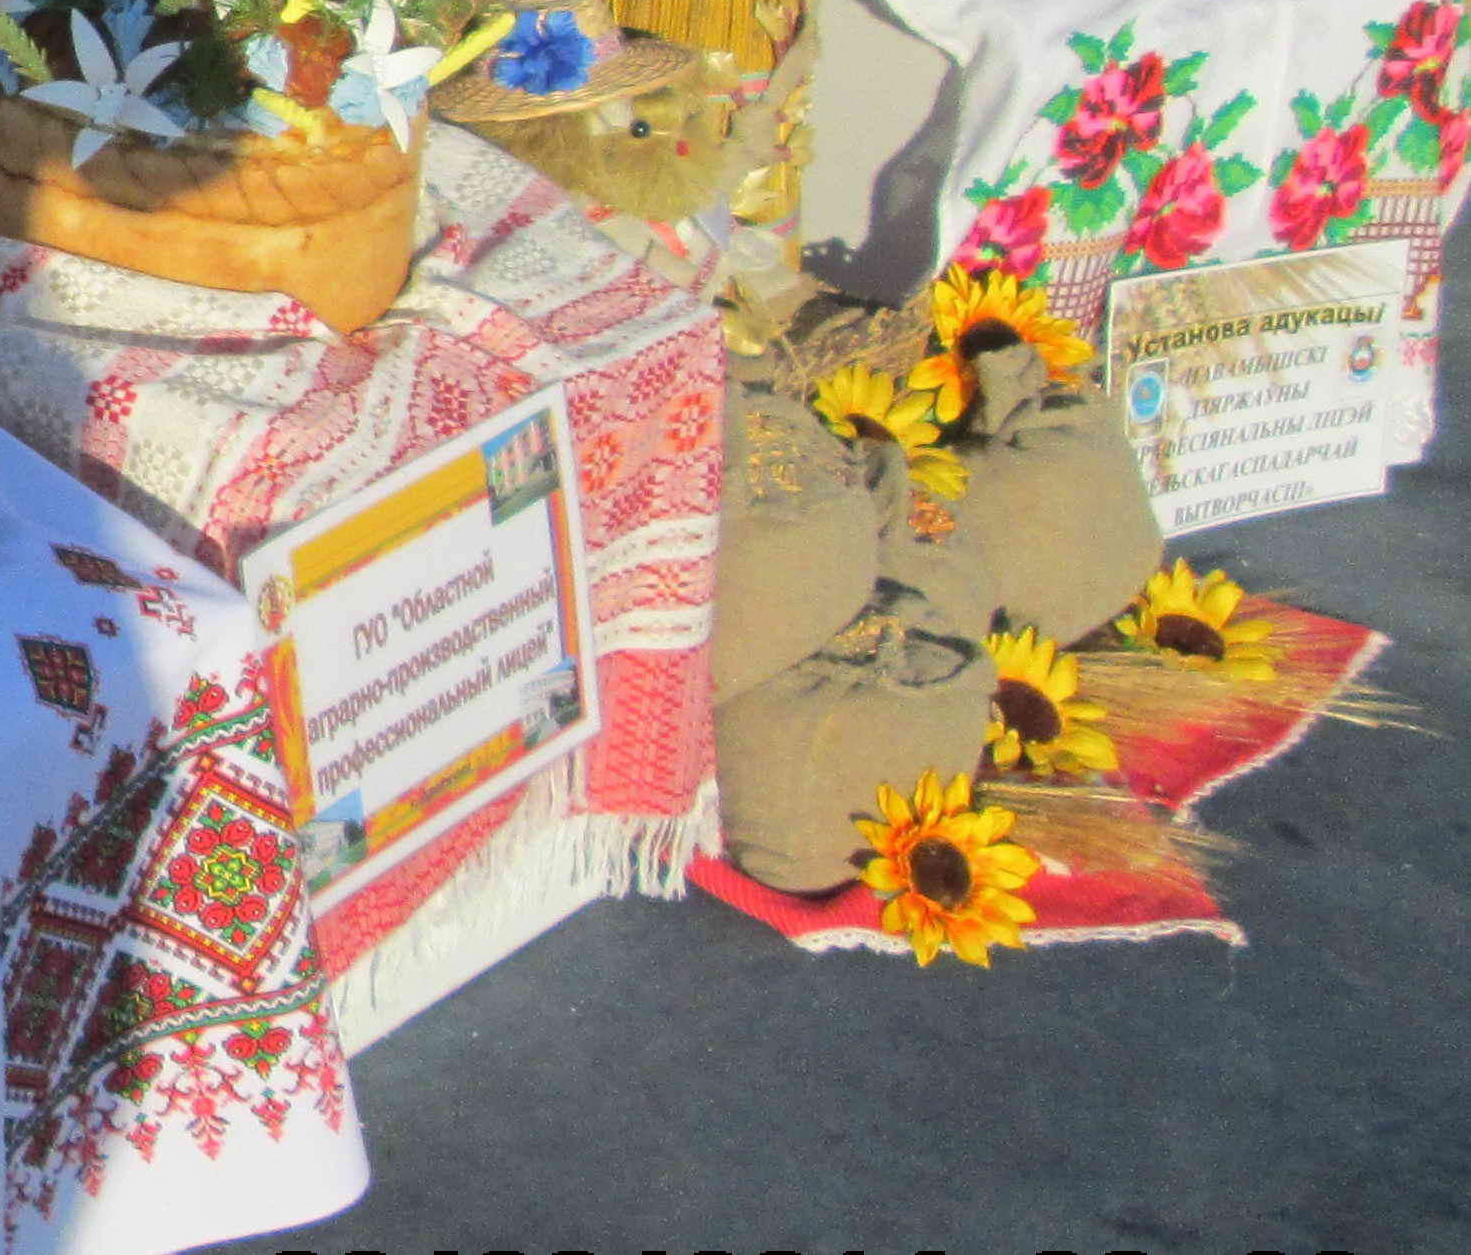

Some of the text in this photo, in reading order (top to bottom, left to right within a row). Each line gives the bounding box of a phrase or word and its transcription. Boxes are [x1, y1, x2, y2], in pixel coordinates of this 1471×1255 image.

[1126, 303, 1387, 361] Установа адукацыі
[1138, 401, 1374, 463] РАФЕСІЯНАЛЬНЫ ЛІЦЭЙ
[1146, 434, 1360, 495] ЕЛЬСКАГАСПАДАРЧАЙ
[353, 548, 495, 659] ГУО "Областной
[308, 567, 556, 745] аграрно-производственный
[317, 656, 494, 796] профессиональный
[497, 619, 555, 682] лицей"
